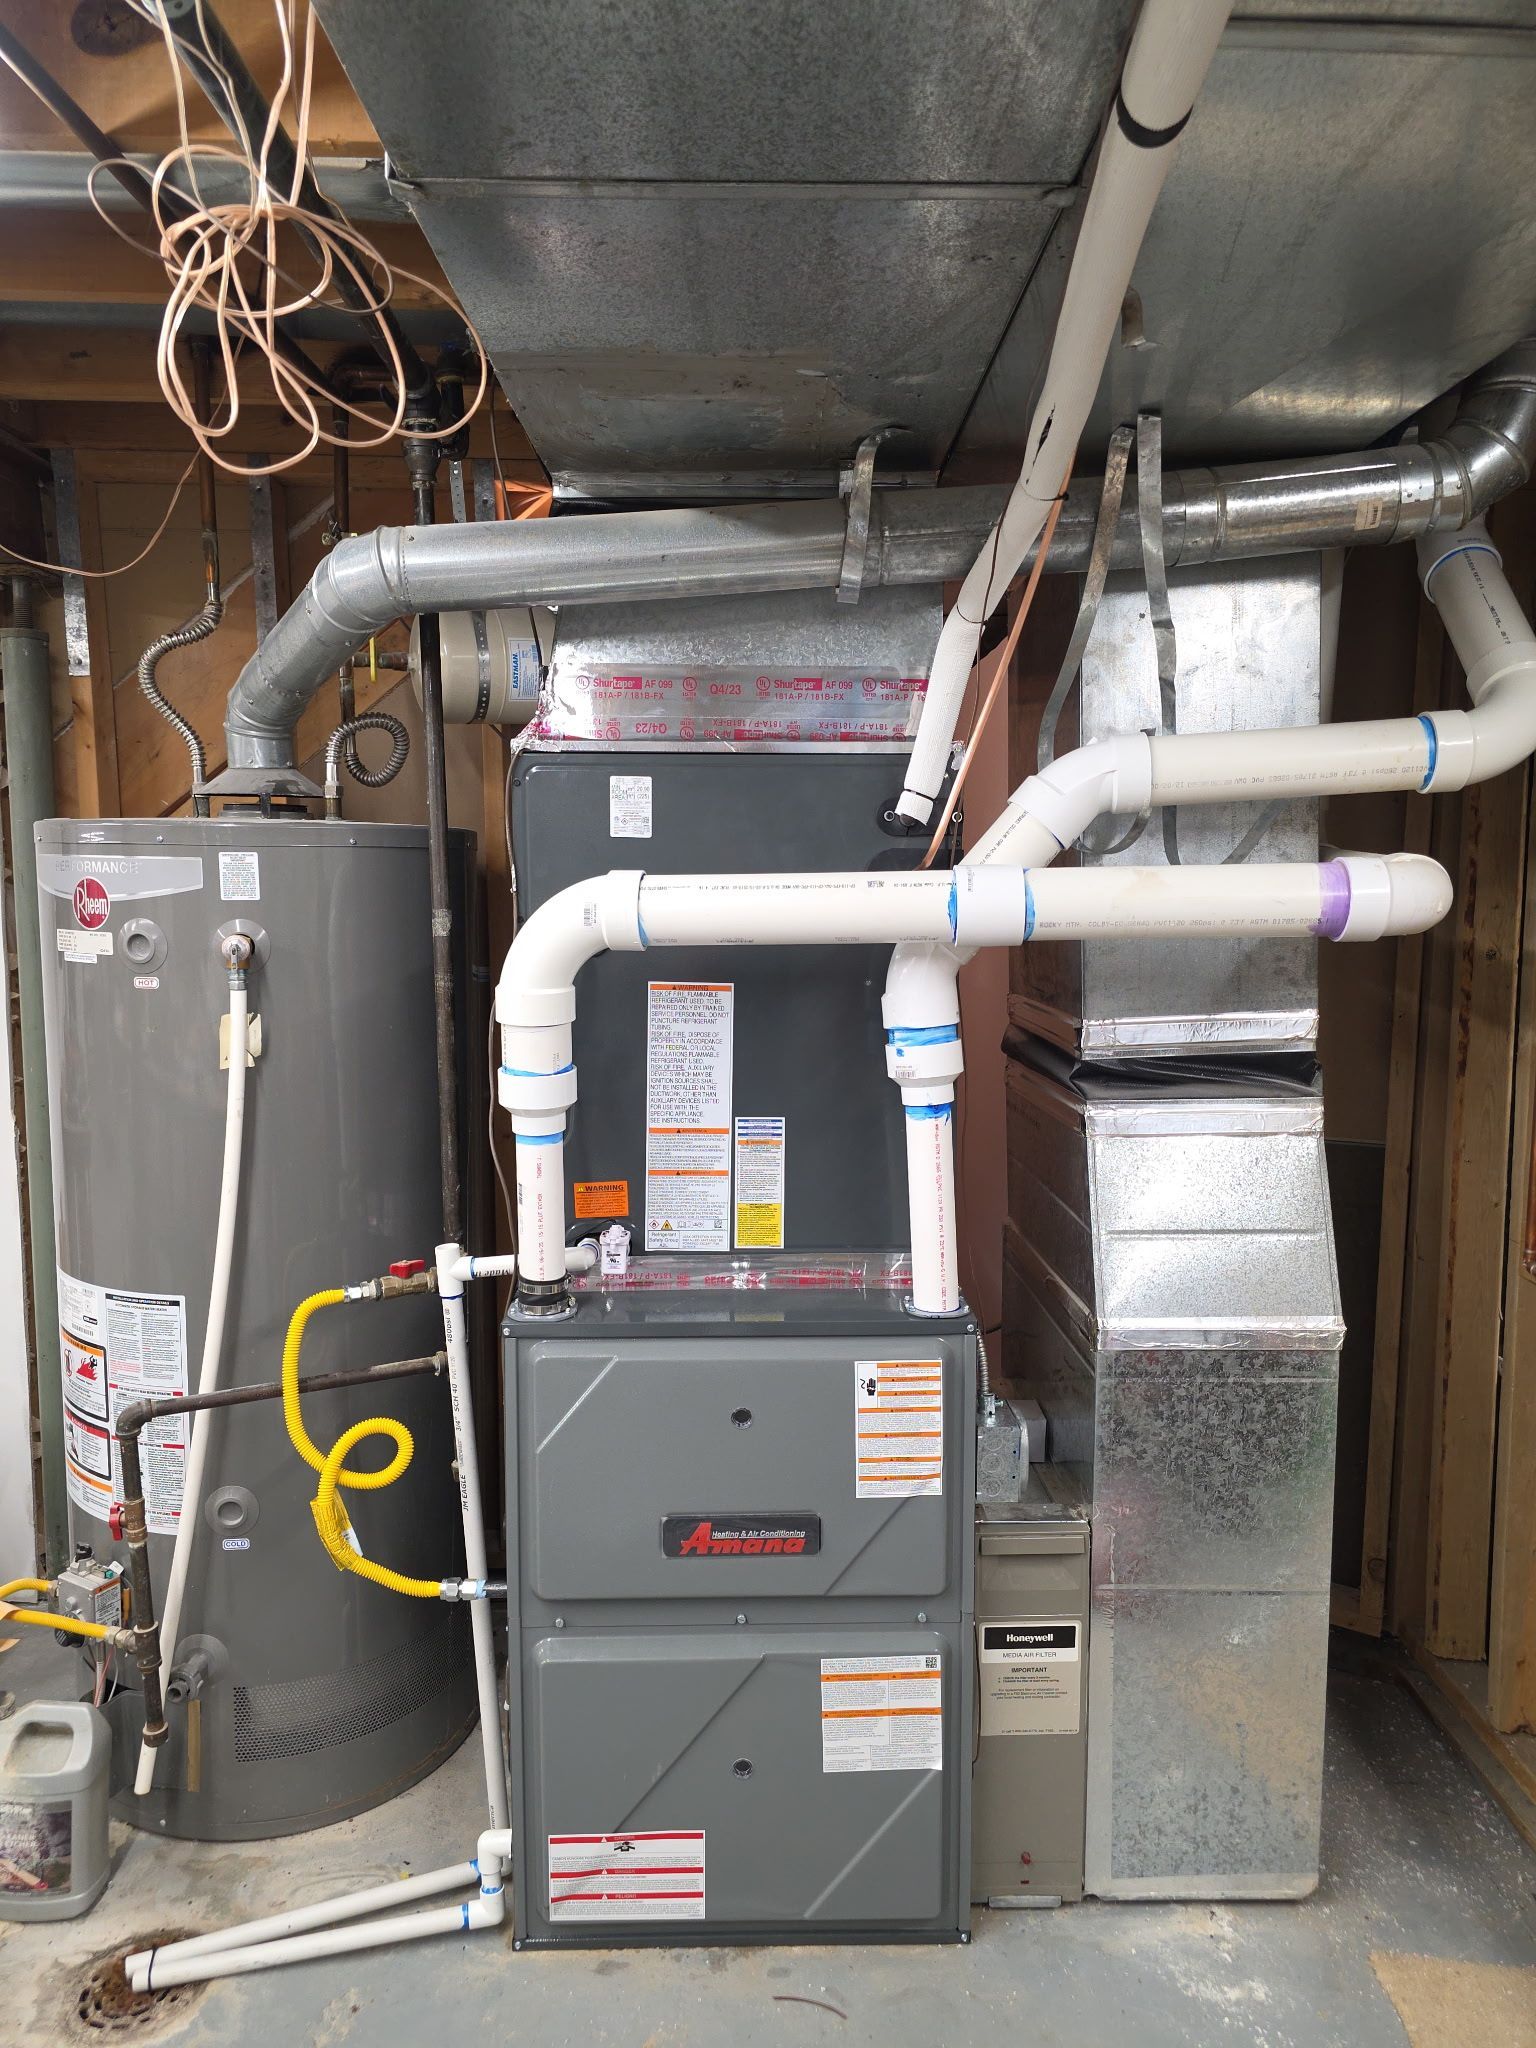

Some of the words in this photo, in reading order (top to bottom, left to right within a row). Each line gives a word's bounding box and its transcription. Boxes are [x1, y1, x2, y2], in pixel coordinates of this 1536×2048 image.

[593, 678, 634, 689] Shurtape
[645, 680, 656, 688] AF
[659, 680, 673, 688] 099
[774, 678, 816, 690] Shurtape
[825, 681, 836, 689] AF
[839, 681, 853, 689] 099
[880, 680, 922, 691] Shurtape
[710, 684, 742, 695] Q4/23
[635, 723, 667, 734] Q4/23
[76, 878, 109, 921] Rheem
[1039, 921, 1062, 929] ROCKY
[485, 1269, 510, 1277] Made
[452, 1384, 457, 1394] 40
[460, 1474, 468, 1499] EAGLE
[463, 1501, 469, 1512] JM
[680, 1522, 806, 1555] Amana
[712, 1530, 740, 1539] Heating
[760, 1529, 806, 1538] Conditioning
[1006, 1633, 1054, 1643] Honeywell
